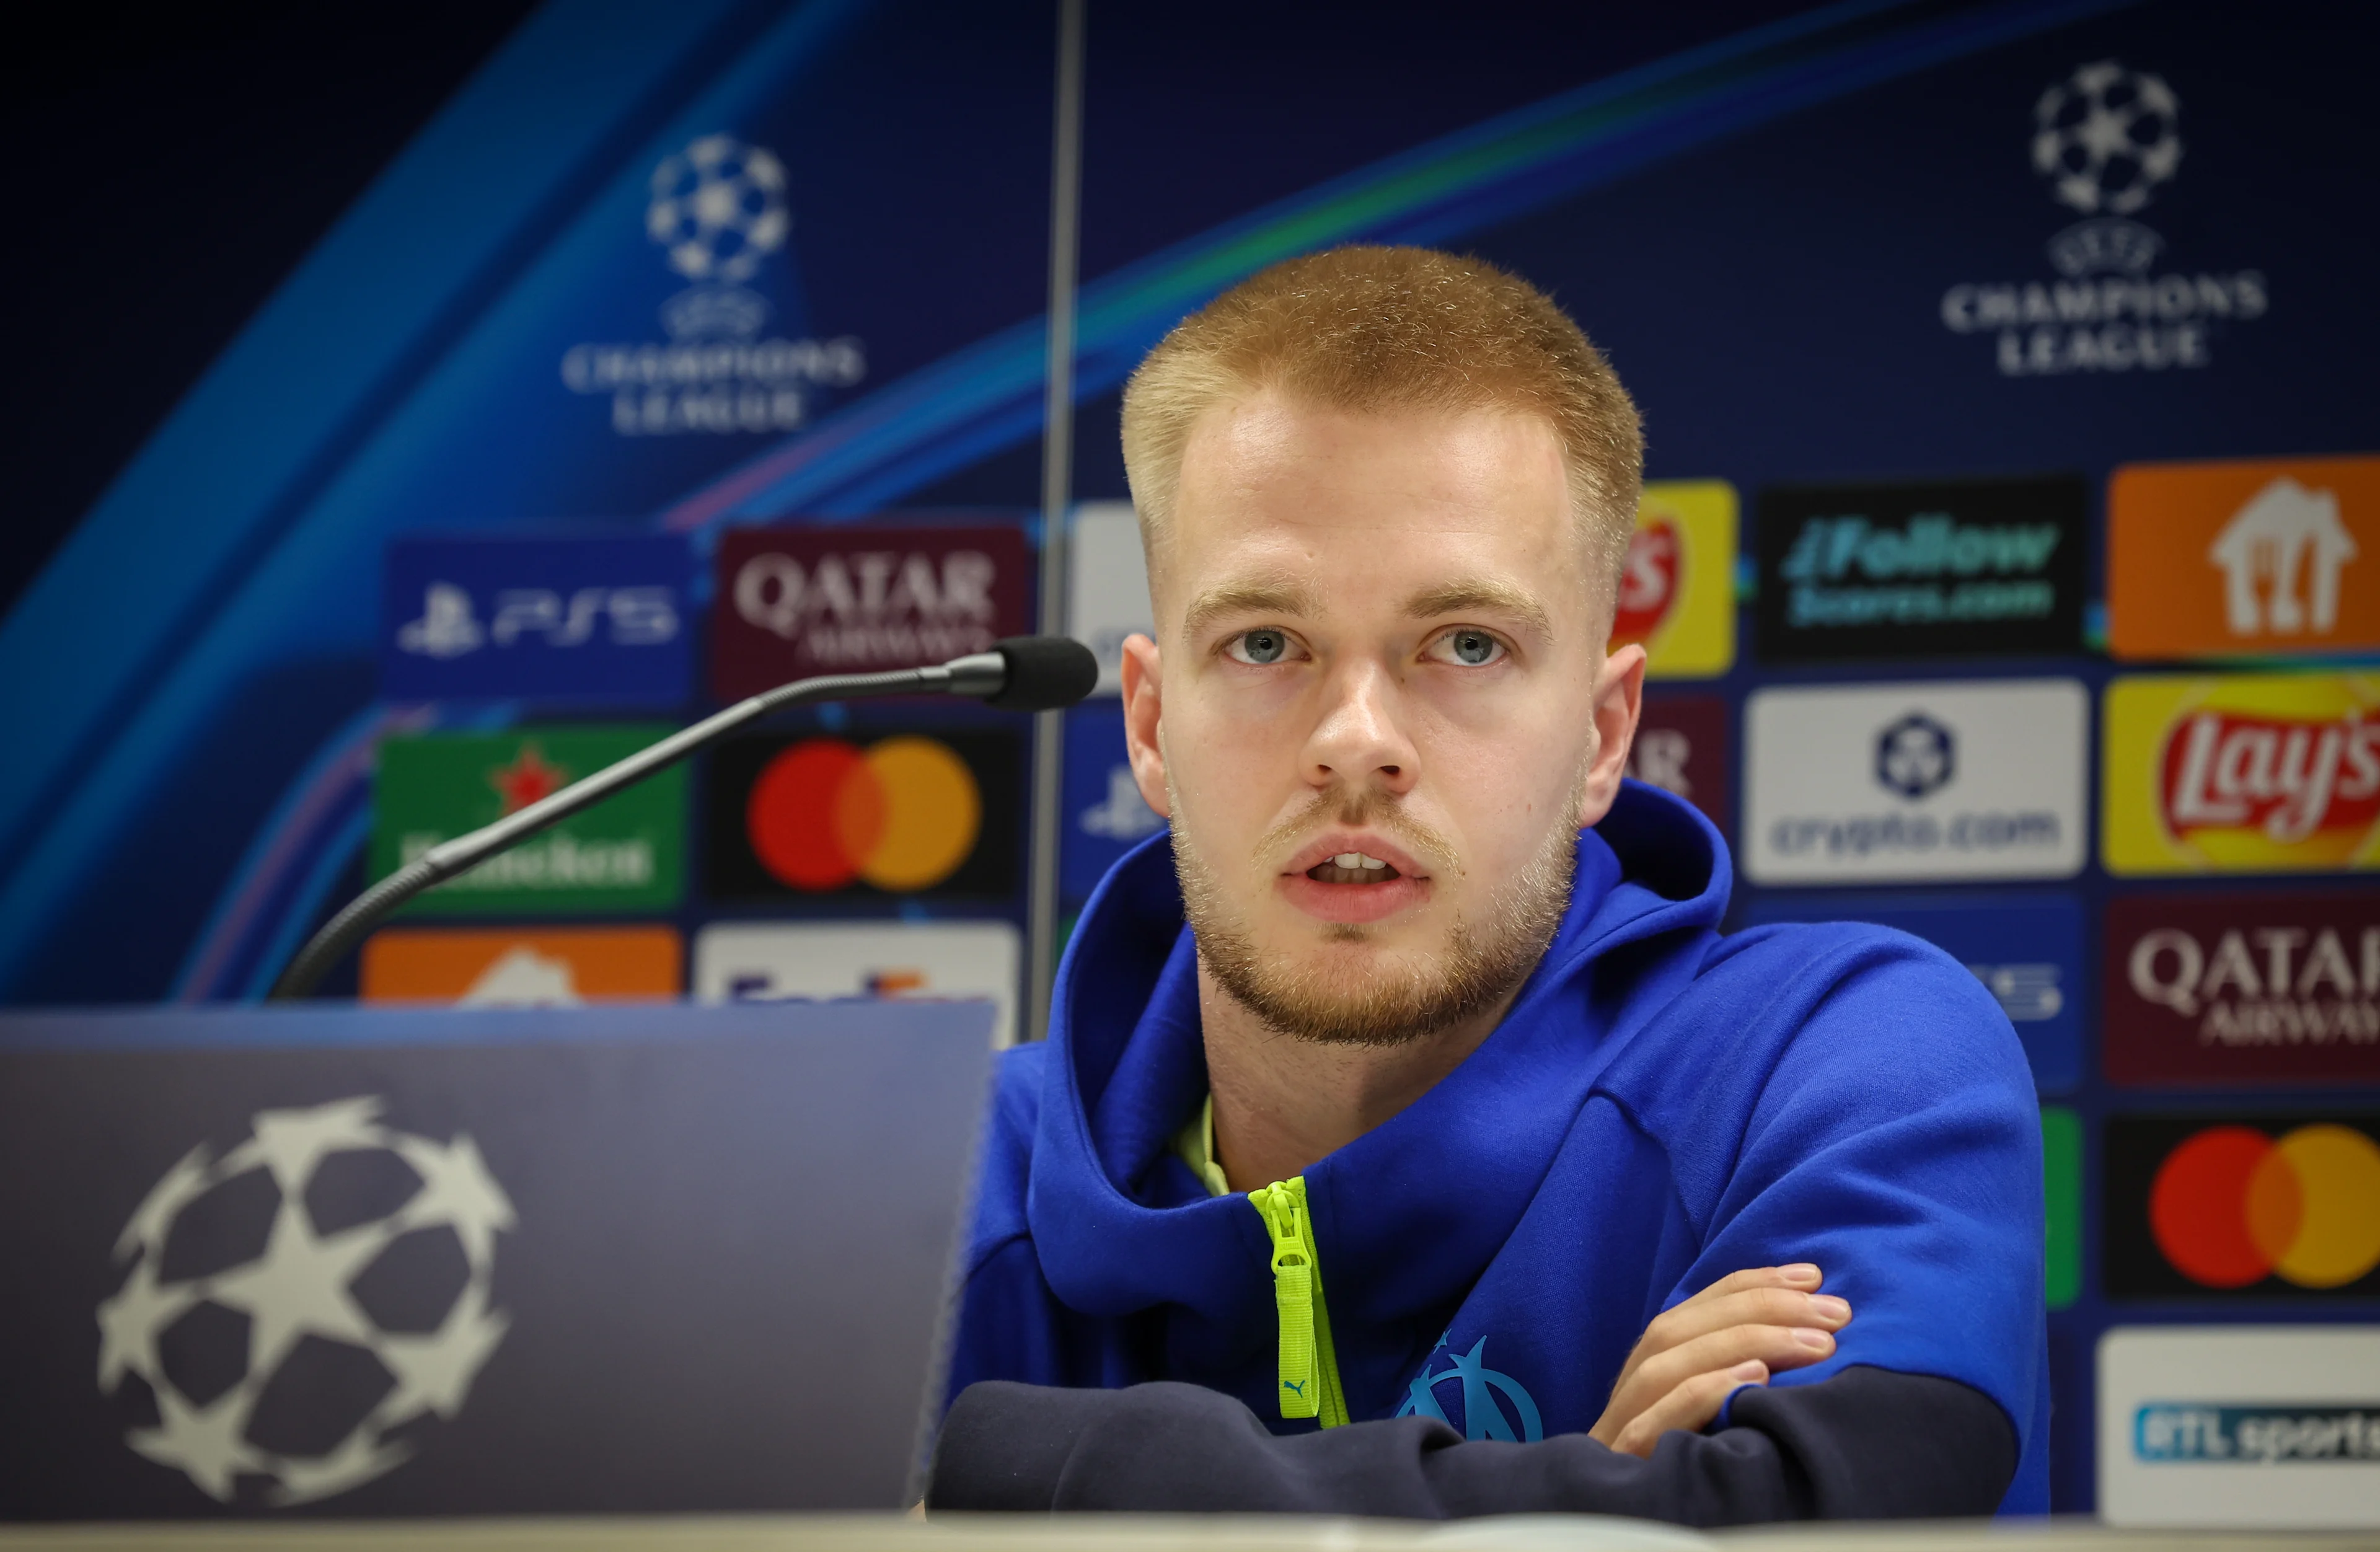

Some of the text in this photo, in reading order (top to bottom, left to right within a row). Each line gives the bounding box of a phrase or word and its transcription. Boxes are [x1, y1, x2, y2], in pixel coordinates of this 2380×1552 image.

[1940, 270, 2267, 335] CHAMPIONS
[562, 338, 865, 394] CHAMPIONS
[1997, 322, 2209, 376] LEAGUE
[612, 392, 801, 434] LEAGUE
[493, 588, 678, 647] PS5
[734, 552, 995, 640] QATAR
[397, 829, 652, 894] ineken
[1770, 812, 2060, 859] crypto.com
